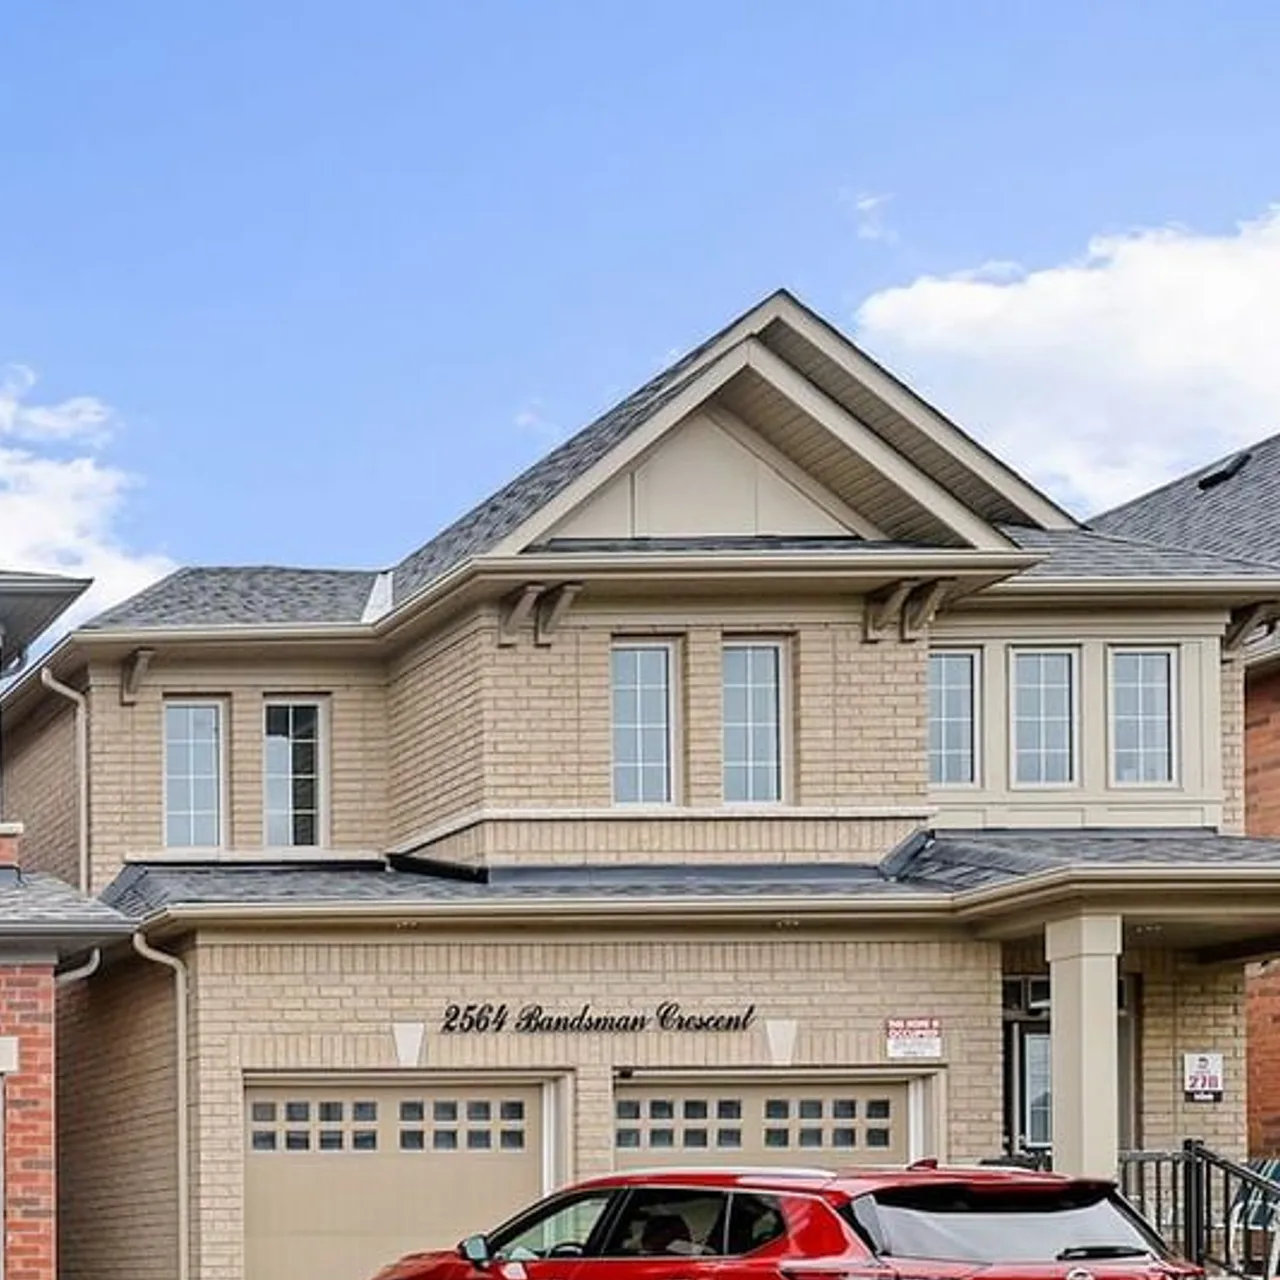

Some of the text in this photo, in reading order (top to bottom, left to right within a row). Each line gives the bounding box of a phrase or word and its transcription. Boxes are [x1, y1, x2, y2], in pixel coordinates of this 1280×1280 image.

[442, 1000, 757, 1033] 2564 Bandsman Crescent
